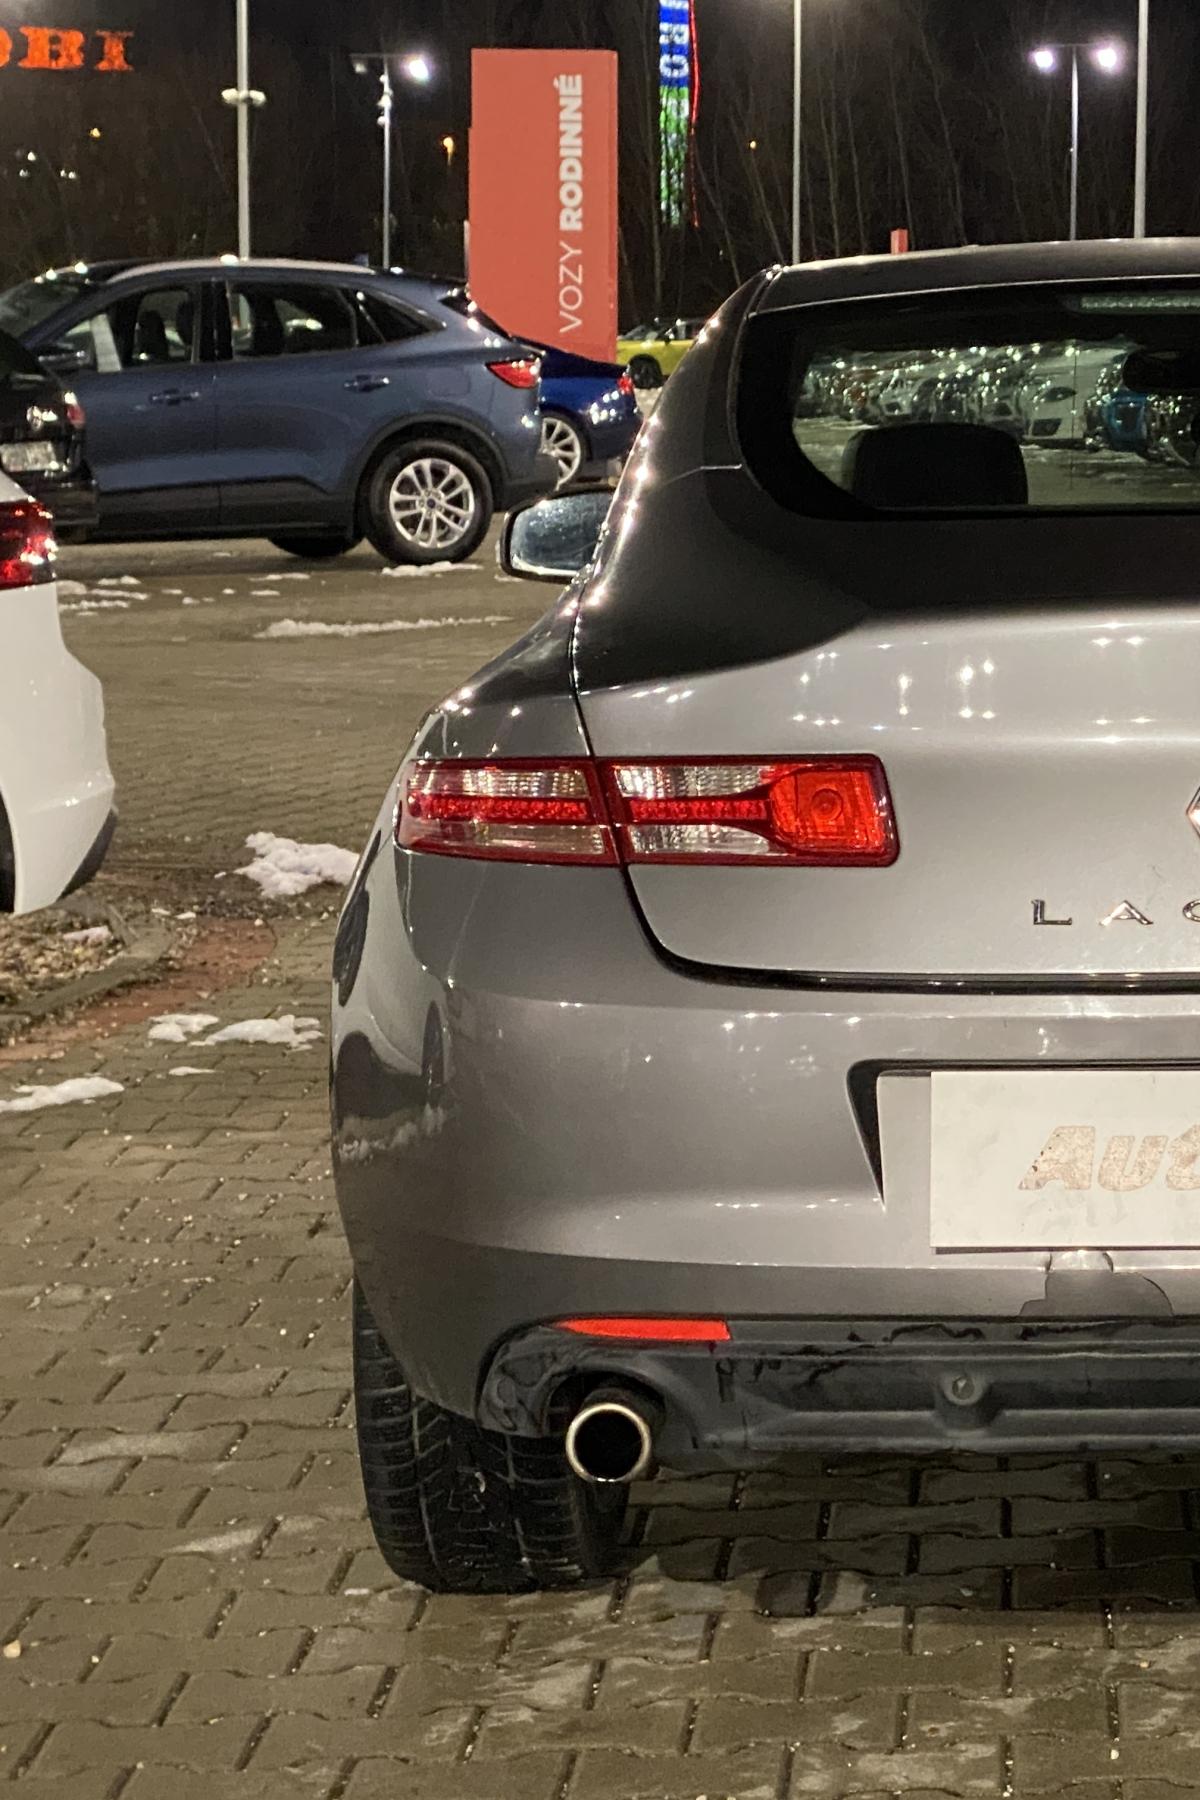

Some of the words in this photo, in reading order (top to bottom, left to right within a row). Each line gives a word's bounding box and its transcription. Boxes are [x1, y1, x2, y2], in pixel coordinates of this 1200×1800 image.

[0, 25, 134, 71] BI
[553, 73, 584, 232] RODINNÉ
[559, 240, 583, 333] VOZY
